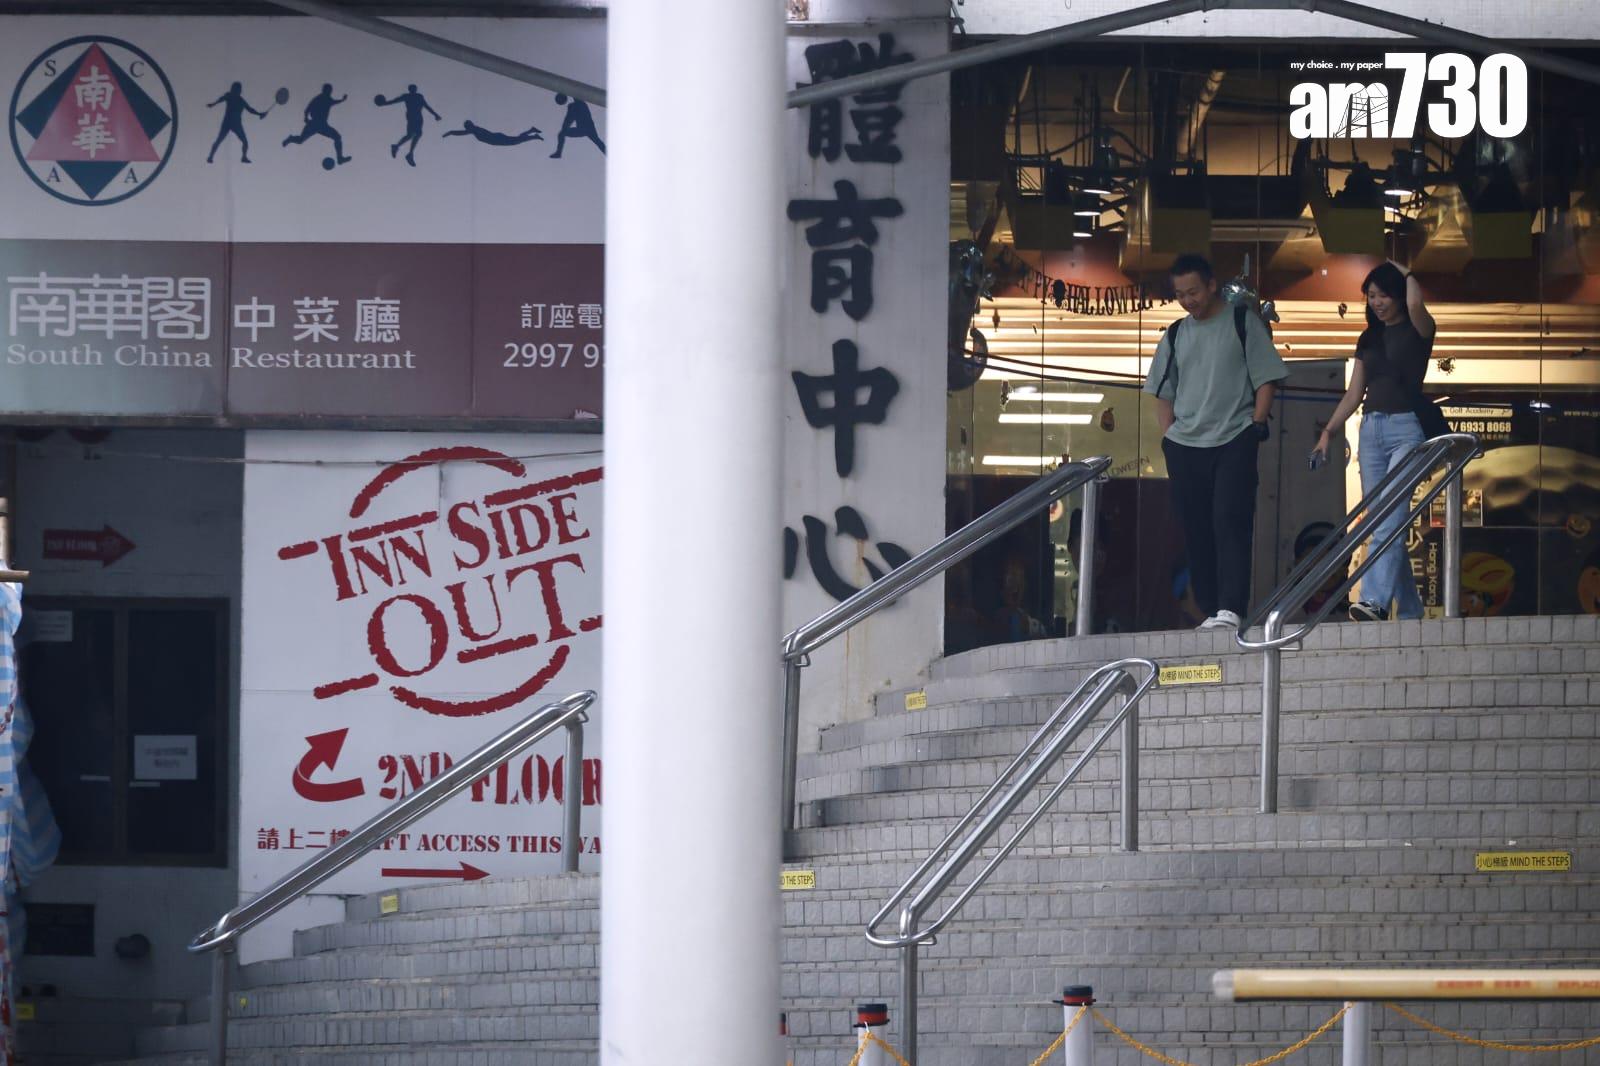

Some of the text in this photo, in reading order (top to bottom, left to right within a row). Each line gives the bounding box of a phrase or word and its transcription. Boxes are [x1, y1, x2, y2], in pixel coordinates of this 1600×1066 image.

[44, 60, 145, 78] S C
[72, 65, 116, 159] 南華
[46, 167, 139, 183] A A
[7, 271, 400, 343] 南華閣 中菜廳
[7, 344, 212, 367] South China
[232, 347, 416, 369] Restaurant
[503, 342, 574, 368] 2997
[1461, 421, 1484, 432] 6933
[321, 492, 590, 601] INN SIDE
[367, 553, 585, 677] OUT
[1204, 668, 1220, 678] STEPS
[417, 834, 500, 853] ACCESS
[507, 835, 562, 853] THIS
[1510, 856, 1530, 867] MIND
[1531, 856, 1547, 866] THE
[1547, 856, 1569, 866] STEPS
